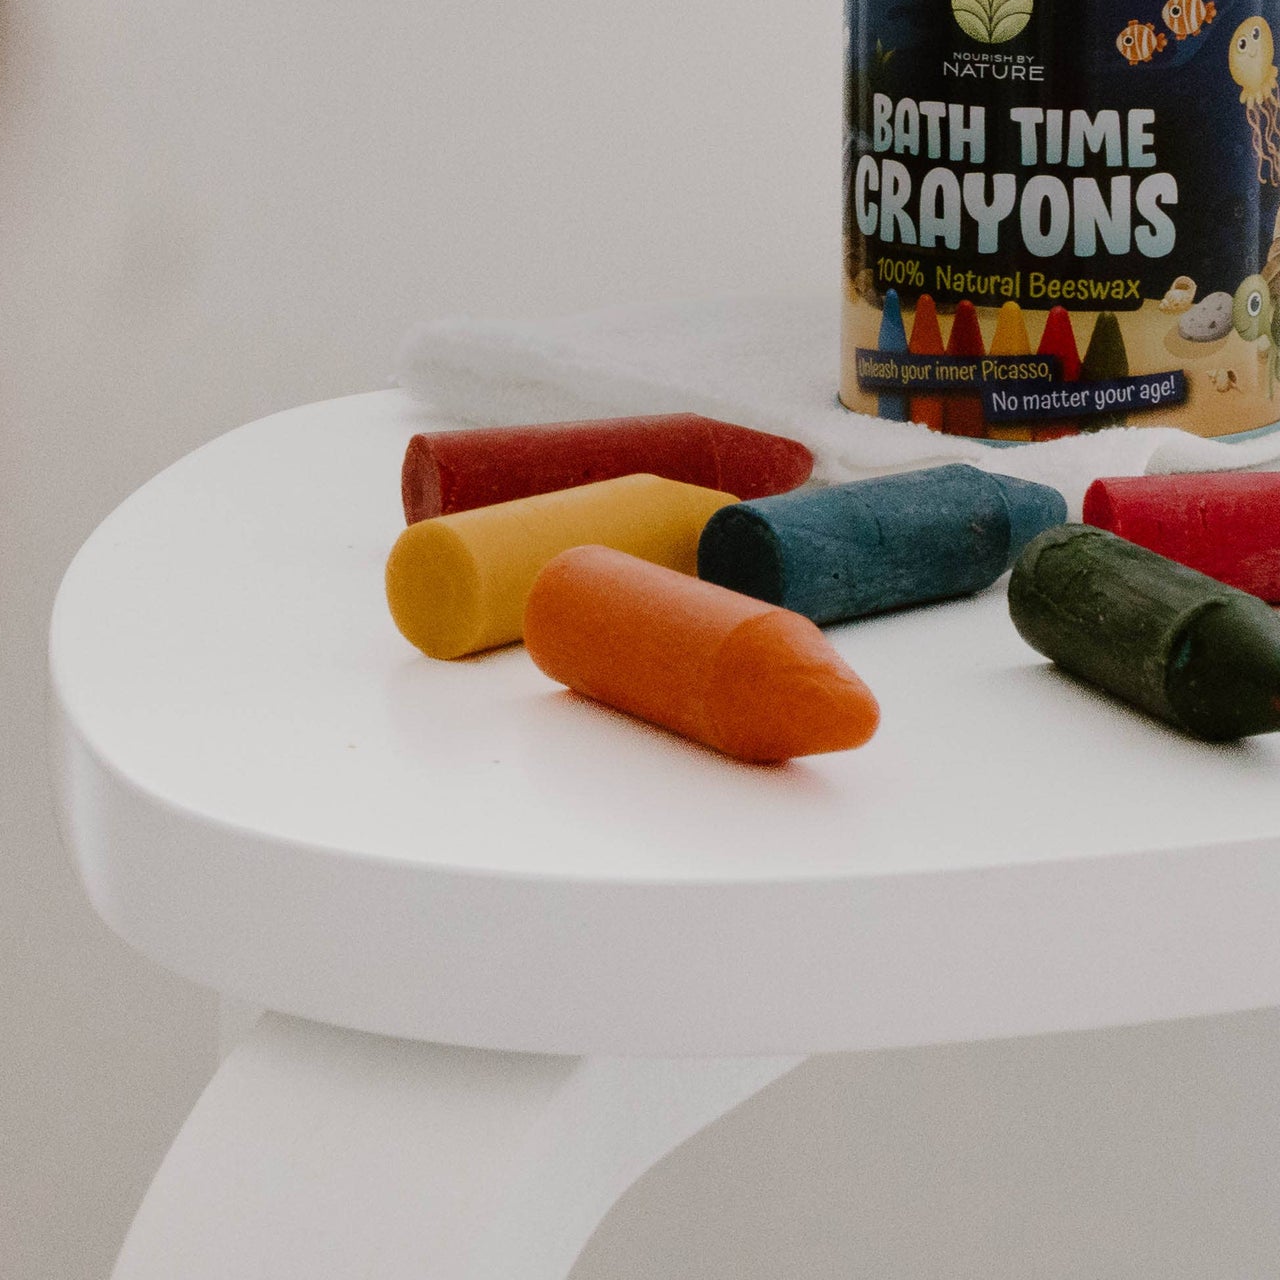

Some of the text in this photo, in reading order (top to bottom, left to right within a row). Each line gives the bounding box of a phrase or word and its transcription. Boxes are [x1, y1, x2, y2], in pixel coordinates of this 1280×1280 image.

[943, 62, 1045, 81] NATURE
[953, 52, 1035, 63] NOURISH BY
[872, 92, 1157, 168] BATH TIME
[855, 154, 1179, 258] CRAYONS
[877, 258, 1141, 300] 100% Natural Beeswax
[901, 363, 932, 384] your
[935, 361, 977, 380] inner
[982, 360, 1053, 382] Picasso,
[992, 375, 1176, 412] No matter your age!
